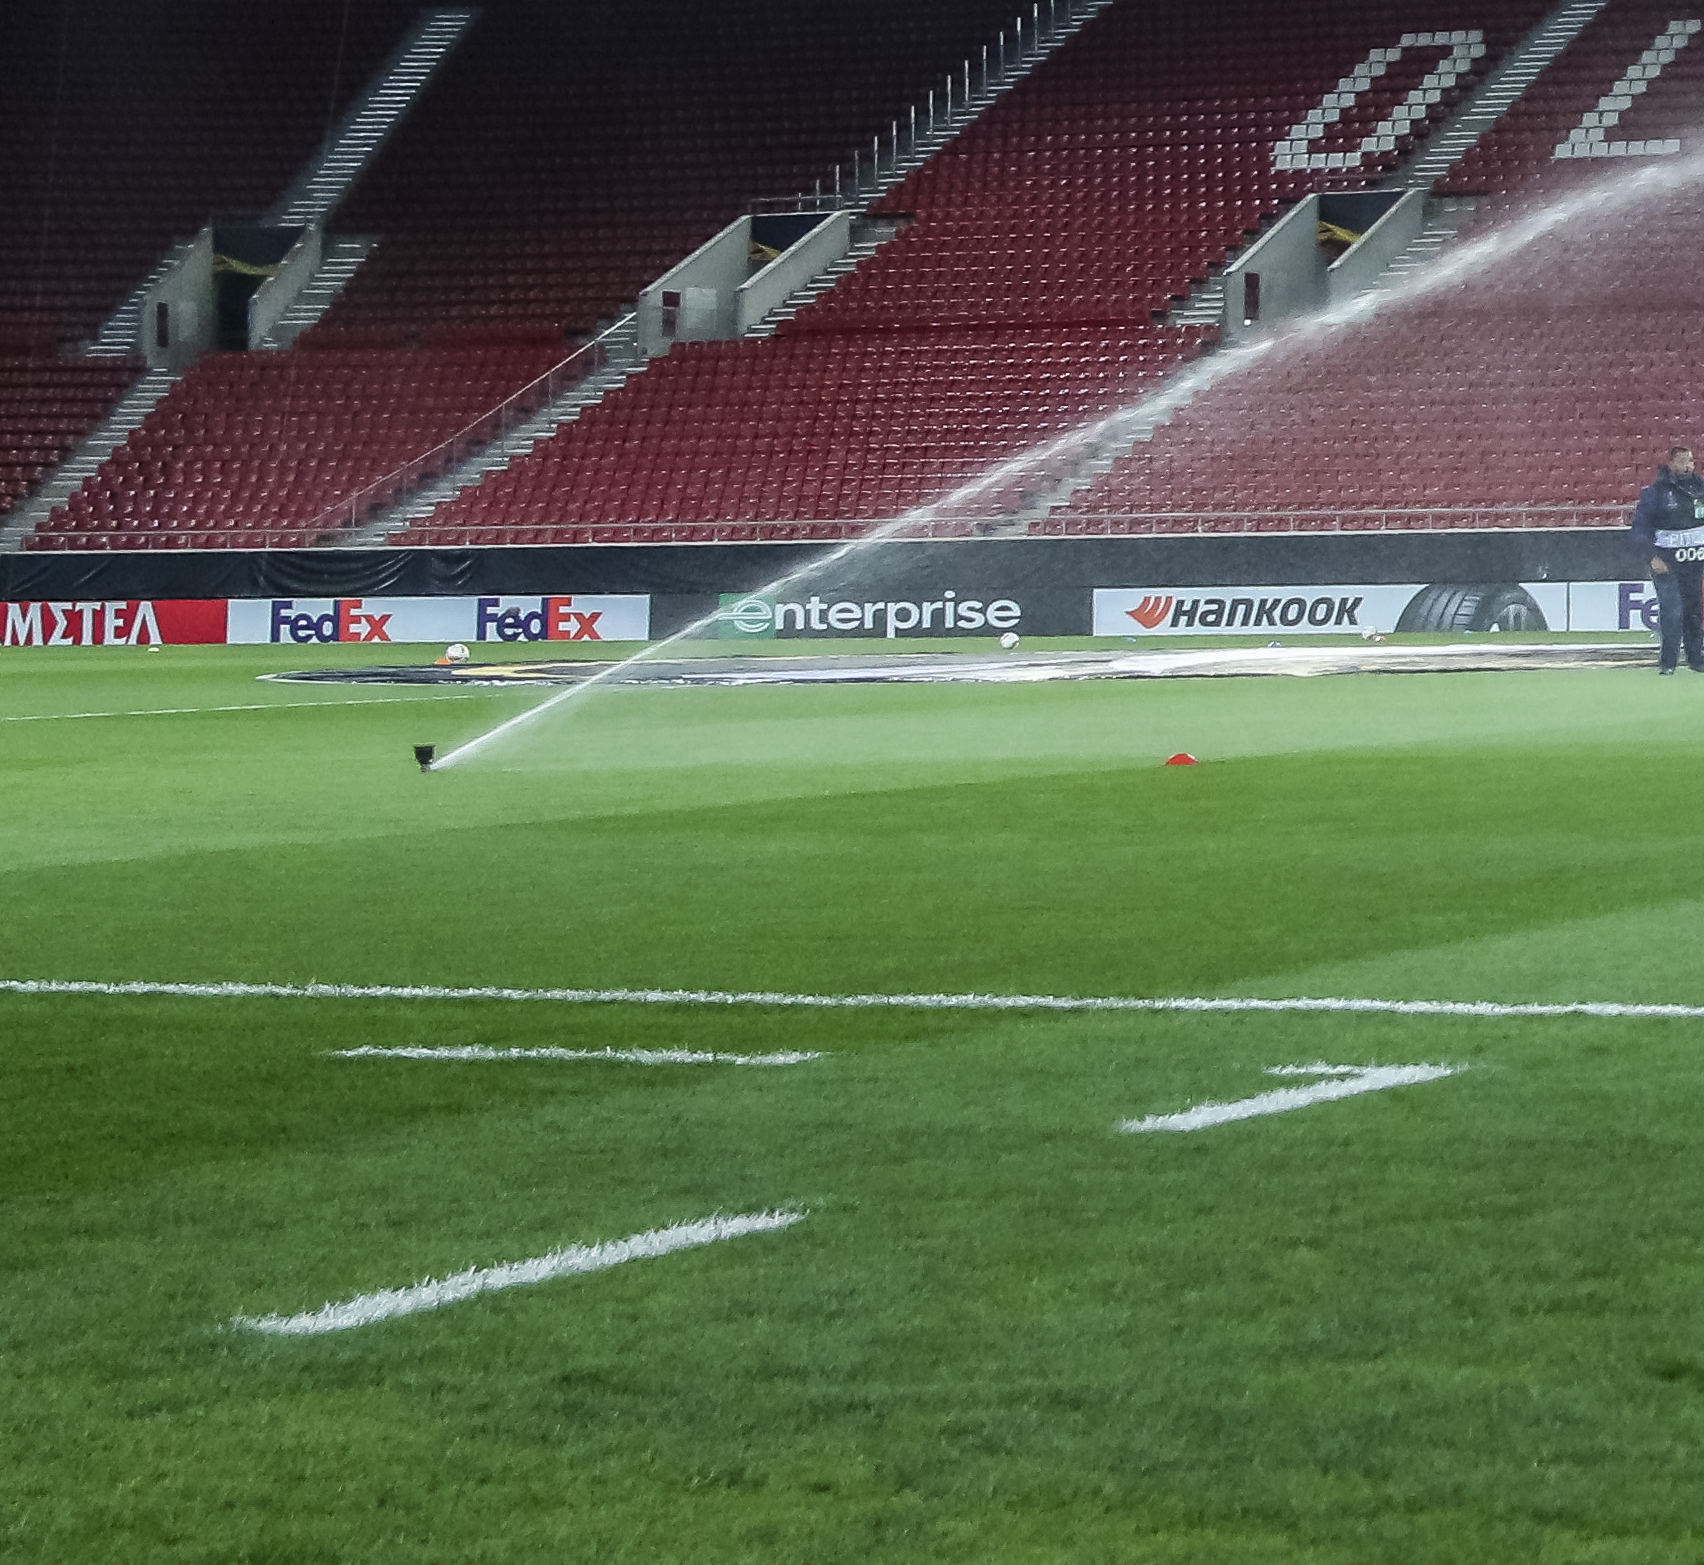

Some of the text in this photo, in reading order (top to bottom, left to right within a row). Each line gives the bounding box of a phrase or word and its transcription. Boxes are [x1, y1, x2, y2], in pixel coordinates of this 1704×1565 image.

[0, 601, 163, 646] ΜΣΤΕΛ
[270, 599, 393, 643] FedEx
[477, 596, 603, 641] FedEx
[720, 590, 1022, 638] enterprise
